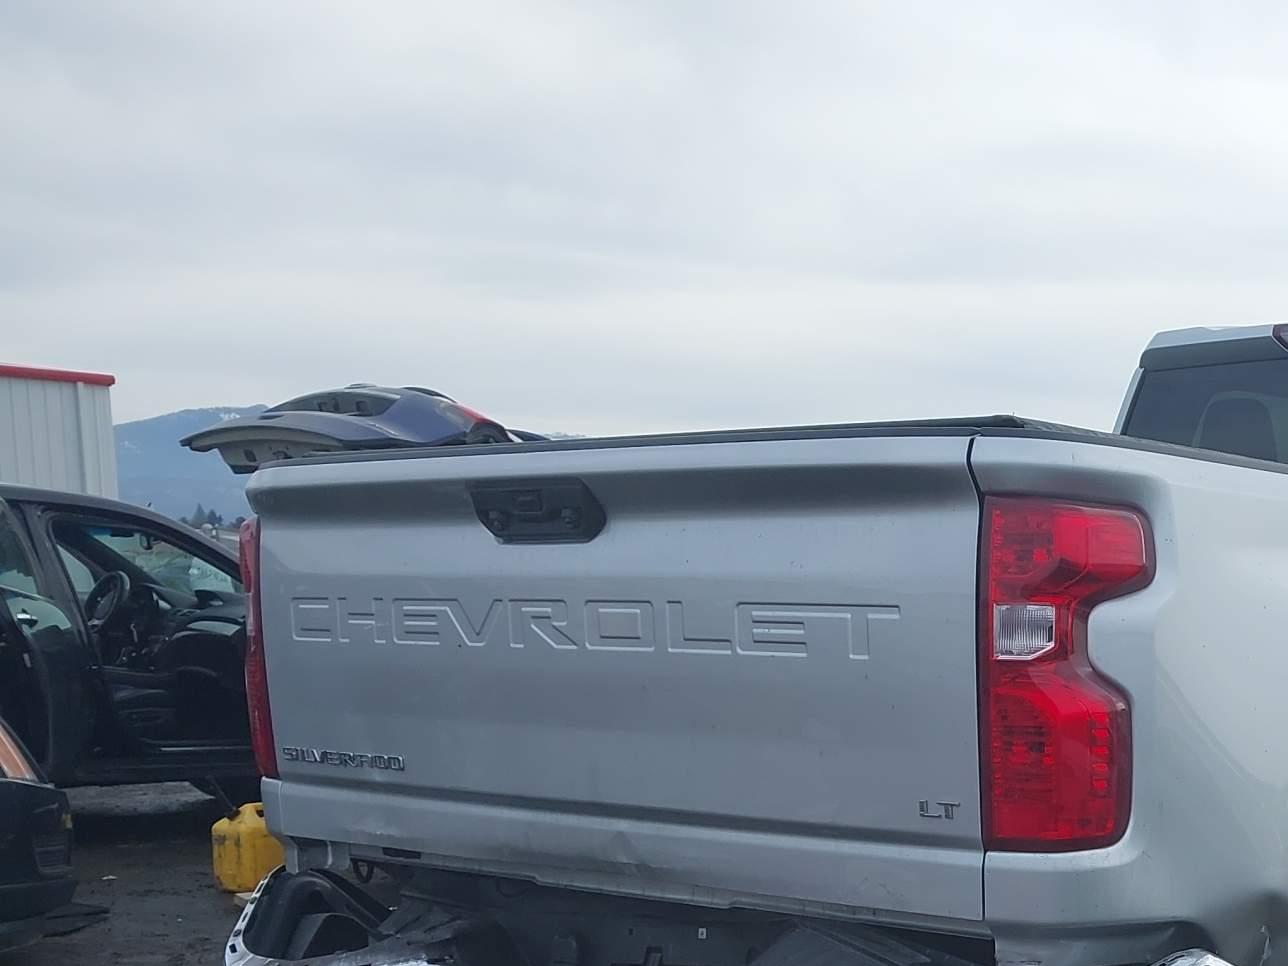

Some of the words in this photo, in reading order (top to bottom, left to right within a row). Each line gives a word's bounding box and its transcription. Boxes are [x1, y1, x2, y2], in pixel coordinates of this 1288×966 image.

[290, 597, 901, 660] CHEVROLET
[282, 745, 406, 772] SILVERADO
[919, 799, 961, 820] LT
